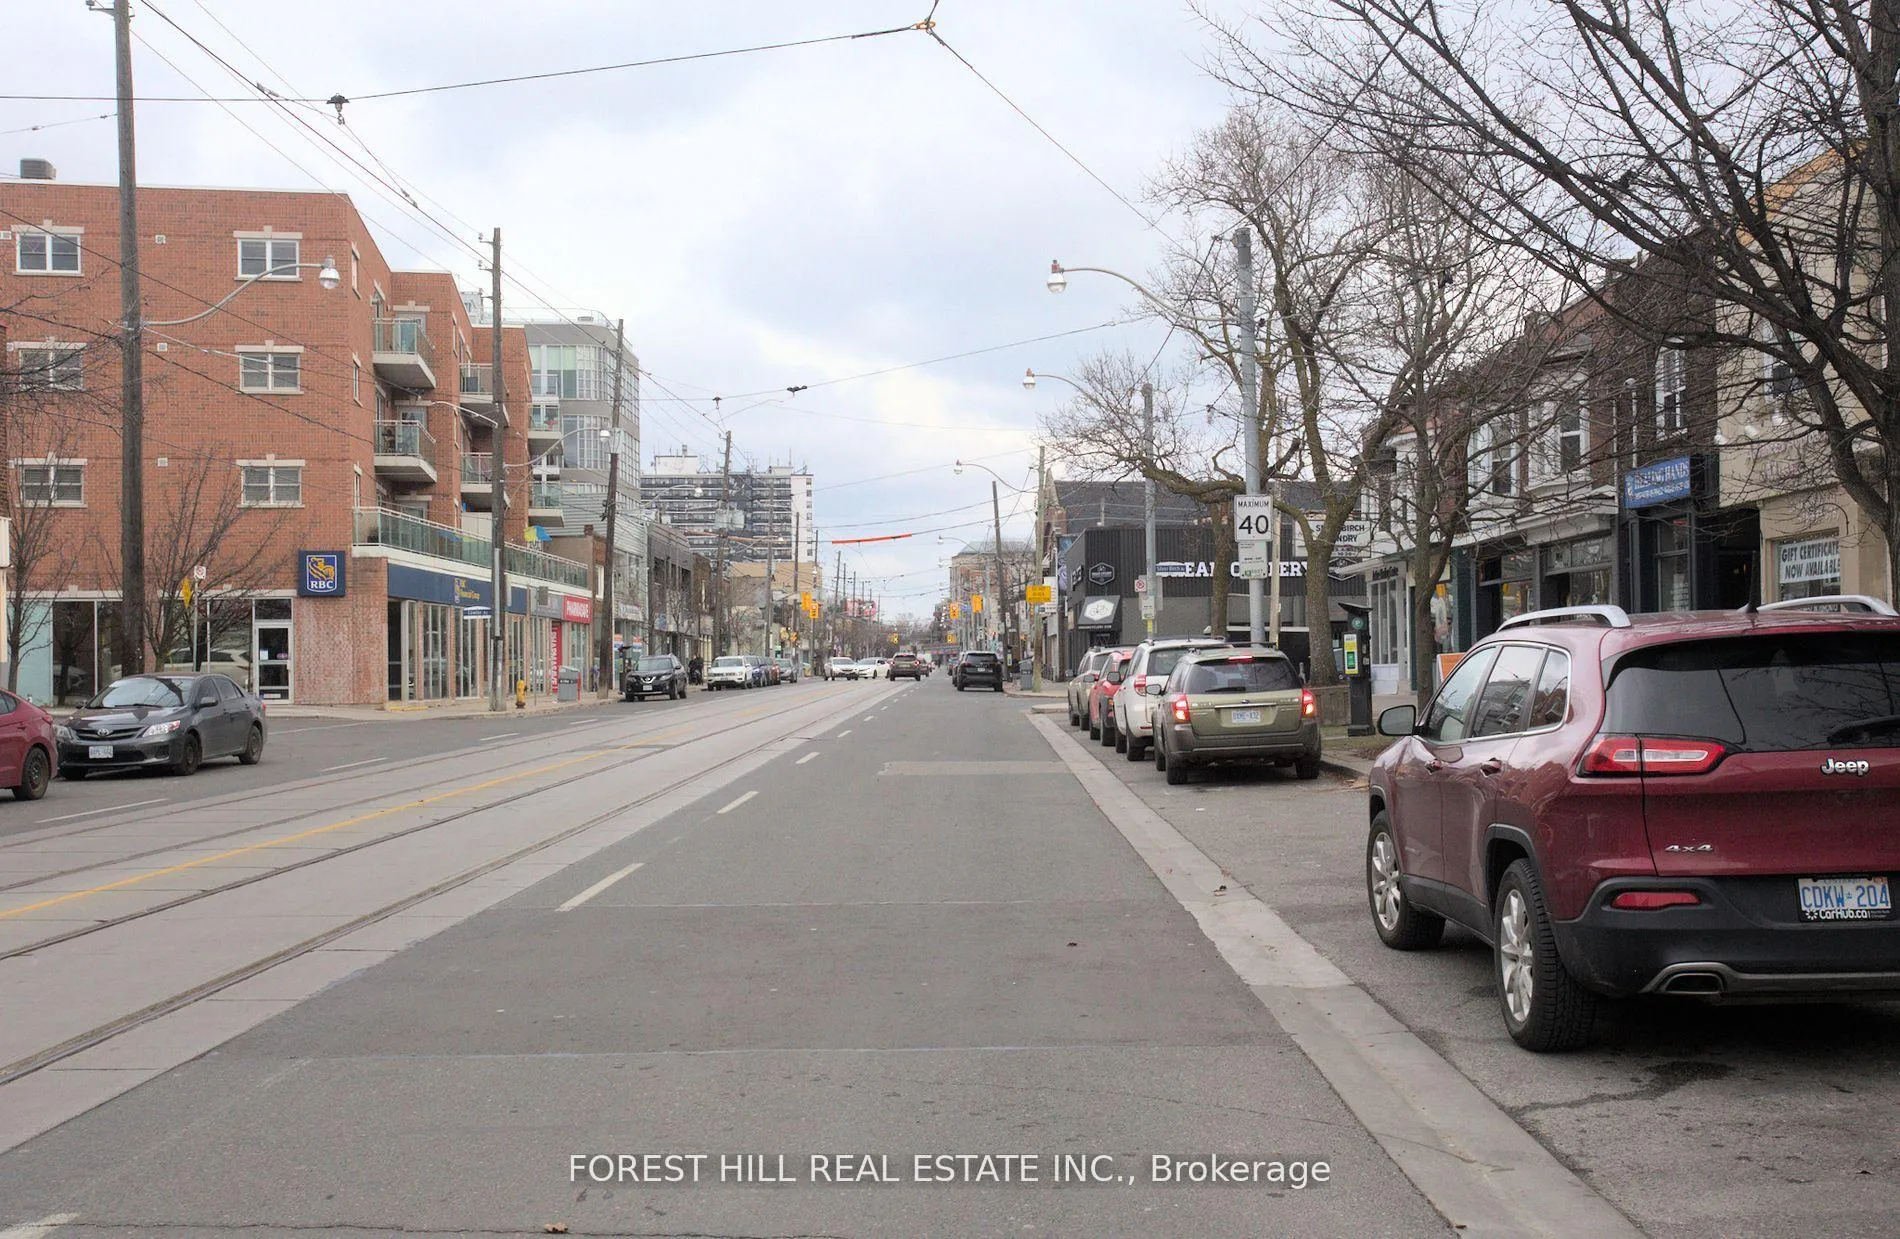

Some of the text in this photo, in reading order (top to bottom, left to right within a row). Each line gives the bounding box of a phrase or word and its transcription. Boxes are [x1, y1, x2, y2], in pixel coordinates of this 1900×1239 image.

[1238, 500, 1269, 508] MAXIMUM
[1238, 514, 1269, 535] 40
[1781, 546, 1798, 563] GIFT
[1785, 563, 1804, 579] NOW
[310, 580, 334, 589] RBC
[1821, 758, 1869, 776] Jeep
[1664, 844, 1713, 853] 4x4
[1801, 884, 1889, 909] CDKW 204
[1819, 909, 1868, 920] CarHub.ca
